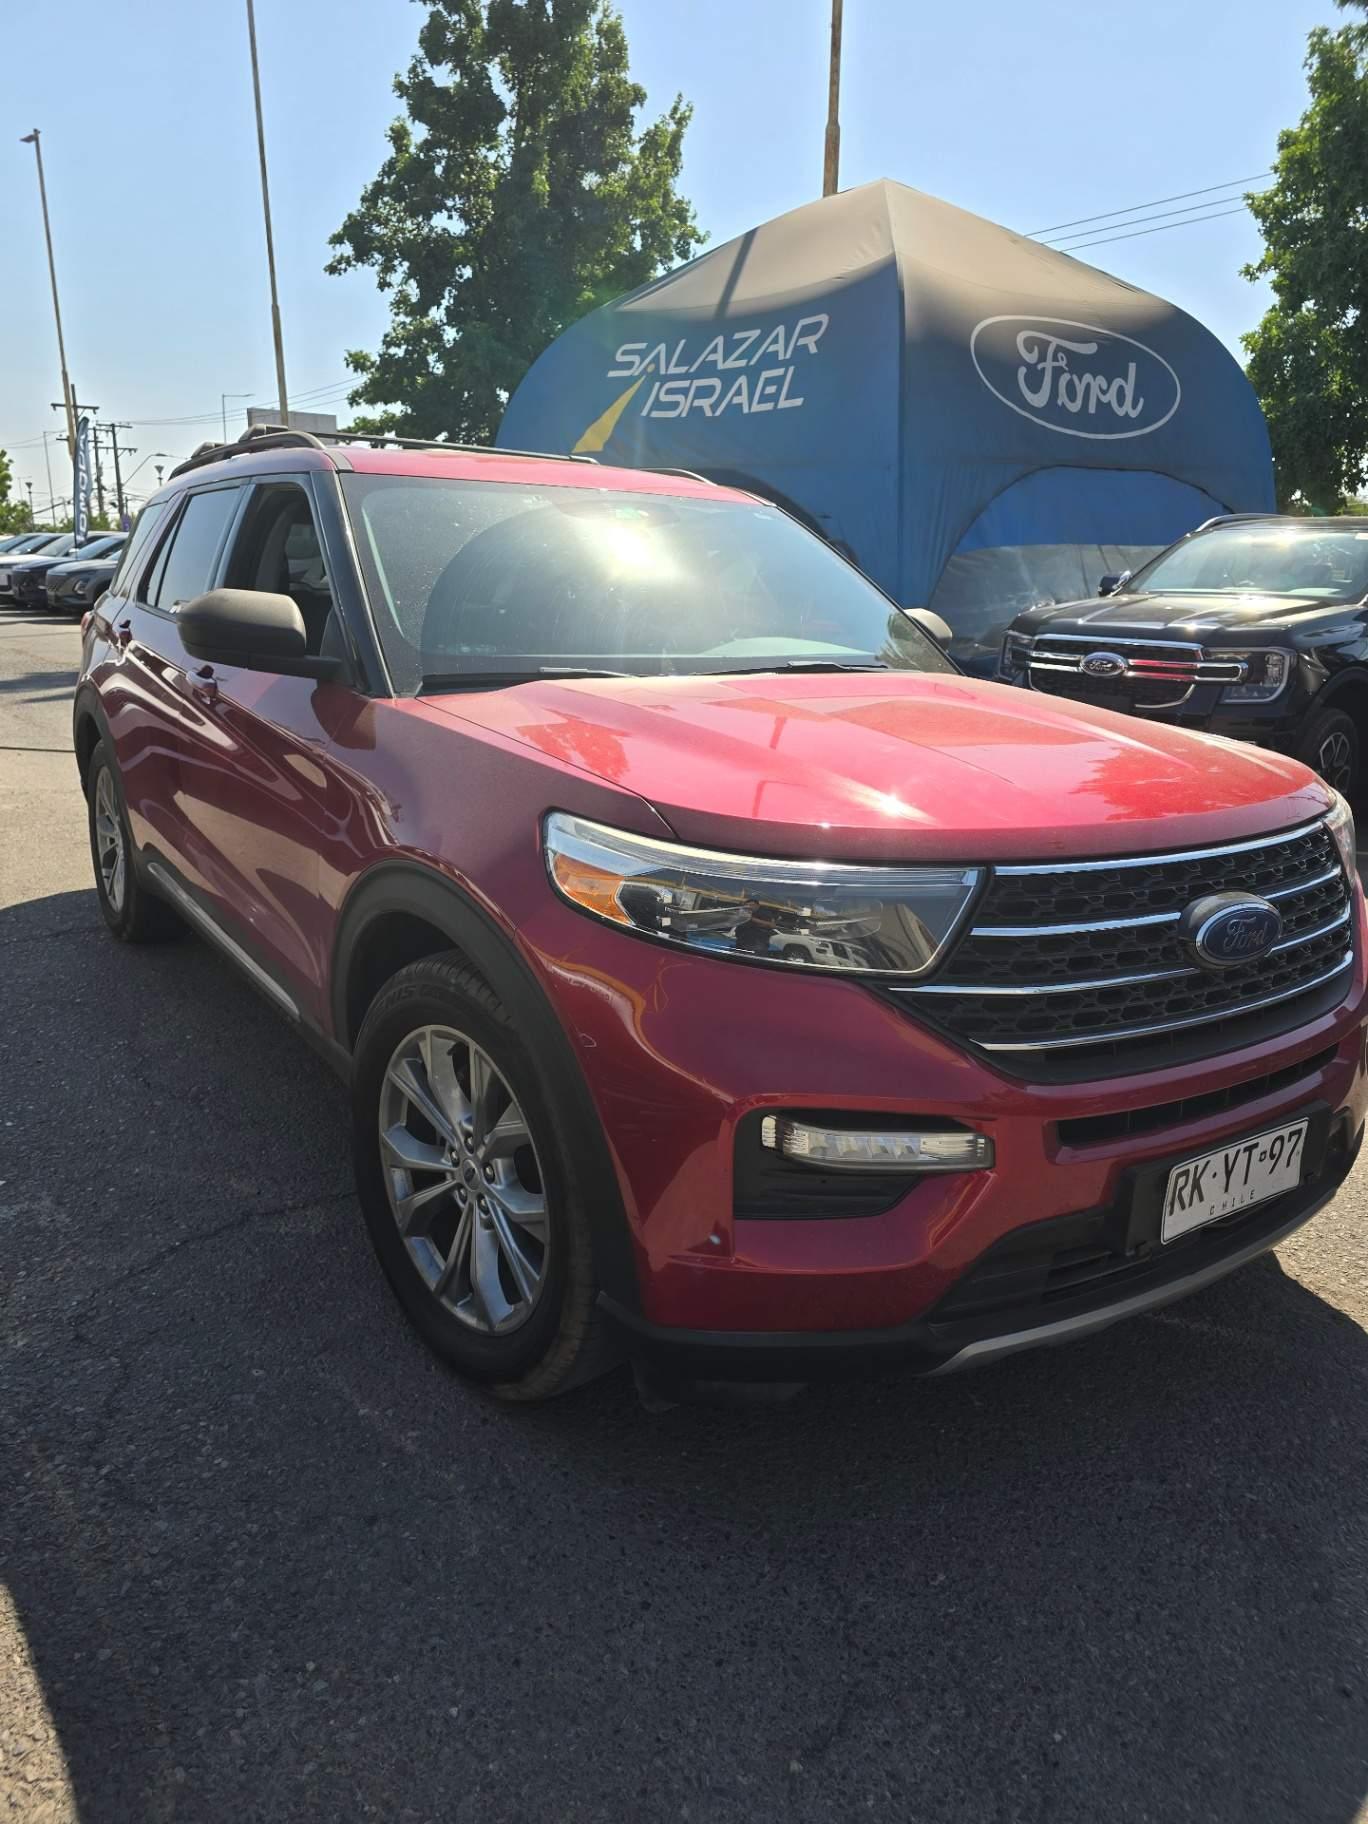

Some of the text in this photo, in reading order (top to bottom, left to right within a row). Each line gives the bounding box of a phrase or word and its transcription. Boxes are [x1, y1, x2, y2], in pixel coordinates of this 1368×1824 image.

[607, 313, 830, 377] SALAZAR
[640, 365, 804, 418] ISRAEL
[1016, 330, 1145, 418] Ford
[1223, 915, 1270, 953] Ford
[1209, 1189, 1255, 1216] CHILE
